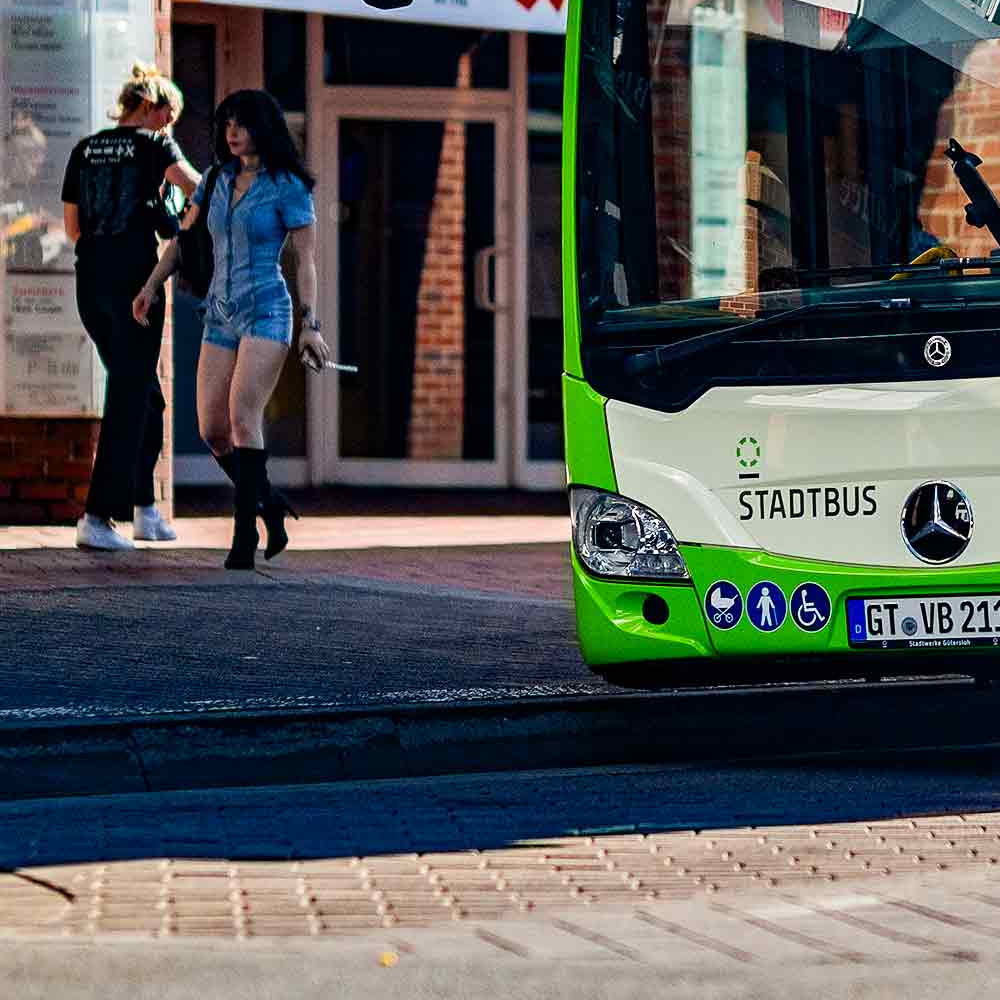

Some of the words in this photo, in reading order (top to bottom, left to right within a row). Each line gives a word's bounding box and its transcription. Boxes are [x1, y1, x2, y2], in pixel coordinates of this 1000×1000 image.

[739, 485, 877, 521] STADTBUS
[855, 624, 862, 634] D
[867, 603, 899, 636] GT
[920, 601, 954, 635] VB
[908, 639, 942, 648] Stadtwerke
[942, 638, 971, 647] Gütersloh
